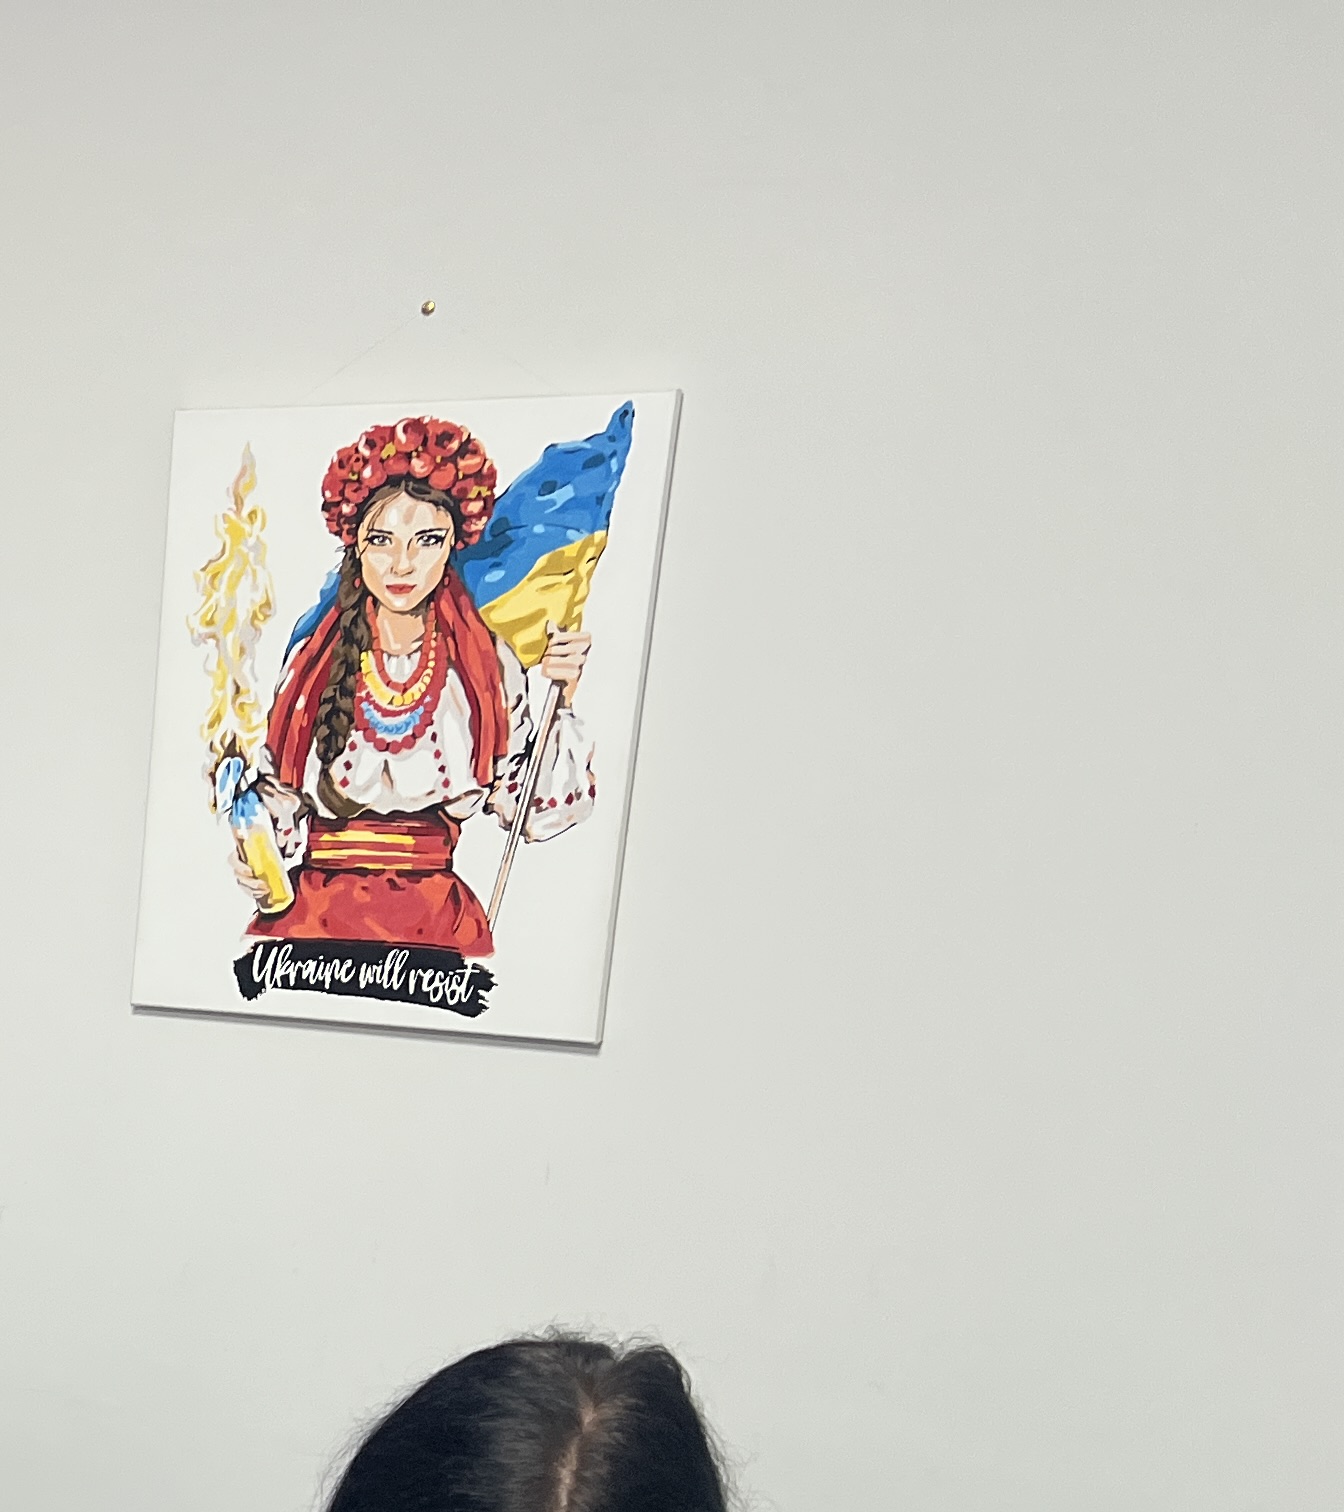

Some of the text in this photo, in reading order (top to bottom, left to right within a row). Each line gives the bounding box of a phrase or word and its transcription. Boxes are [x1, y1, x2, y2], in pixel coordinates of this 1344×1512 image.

[252, 943, 478, 1006] Ukraine will resist
